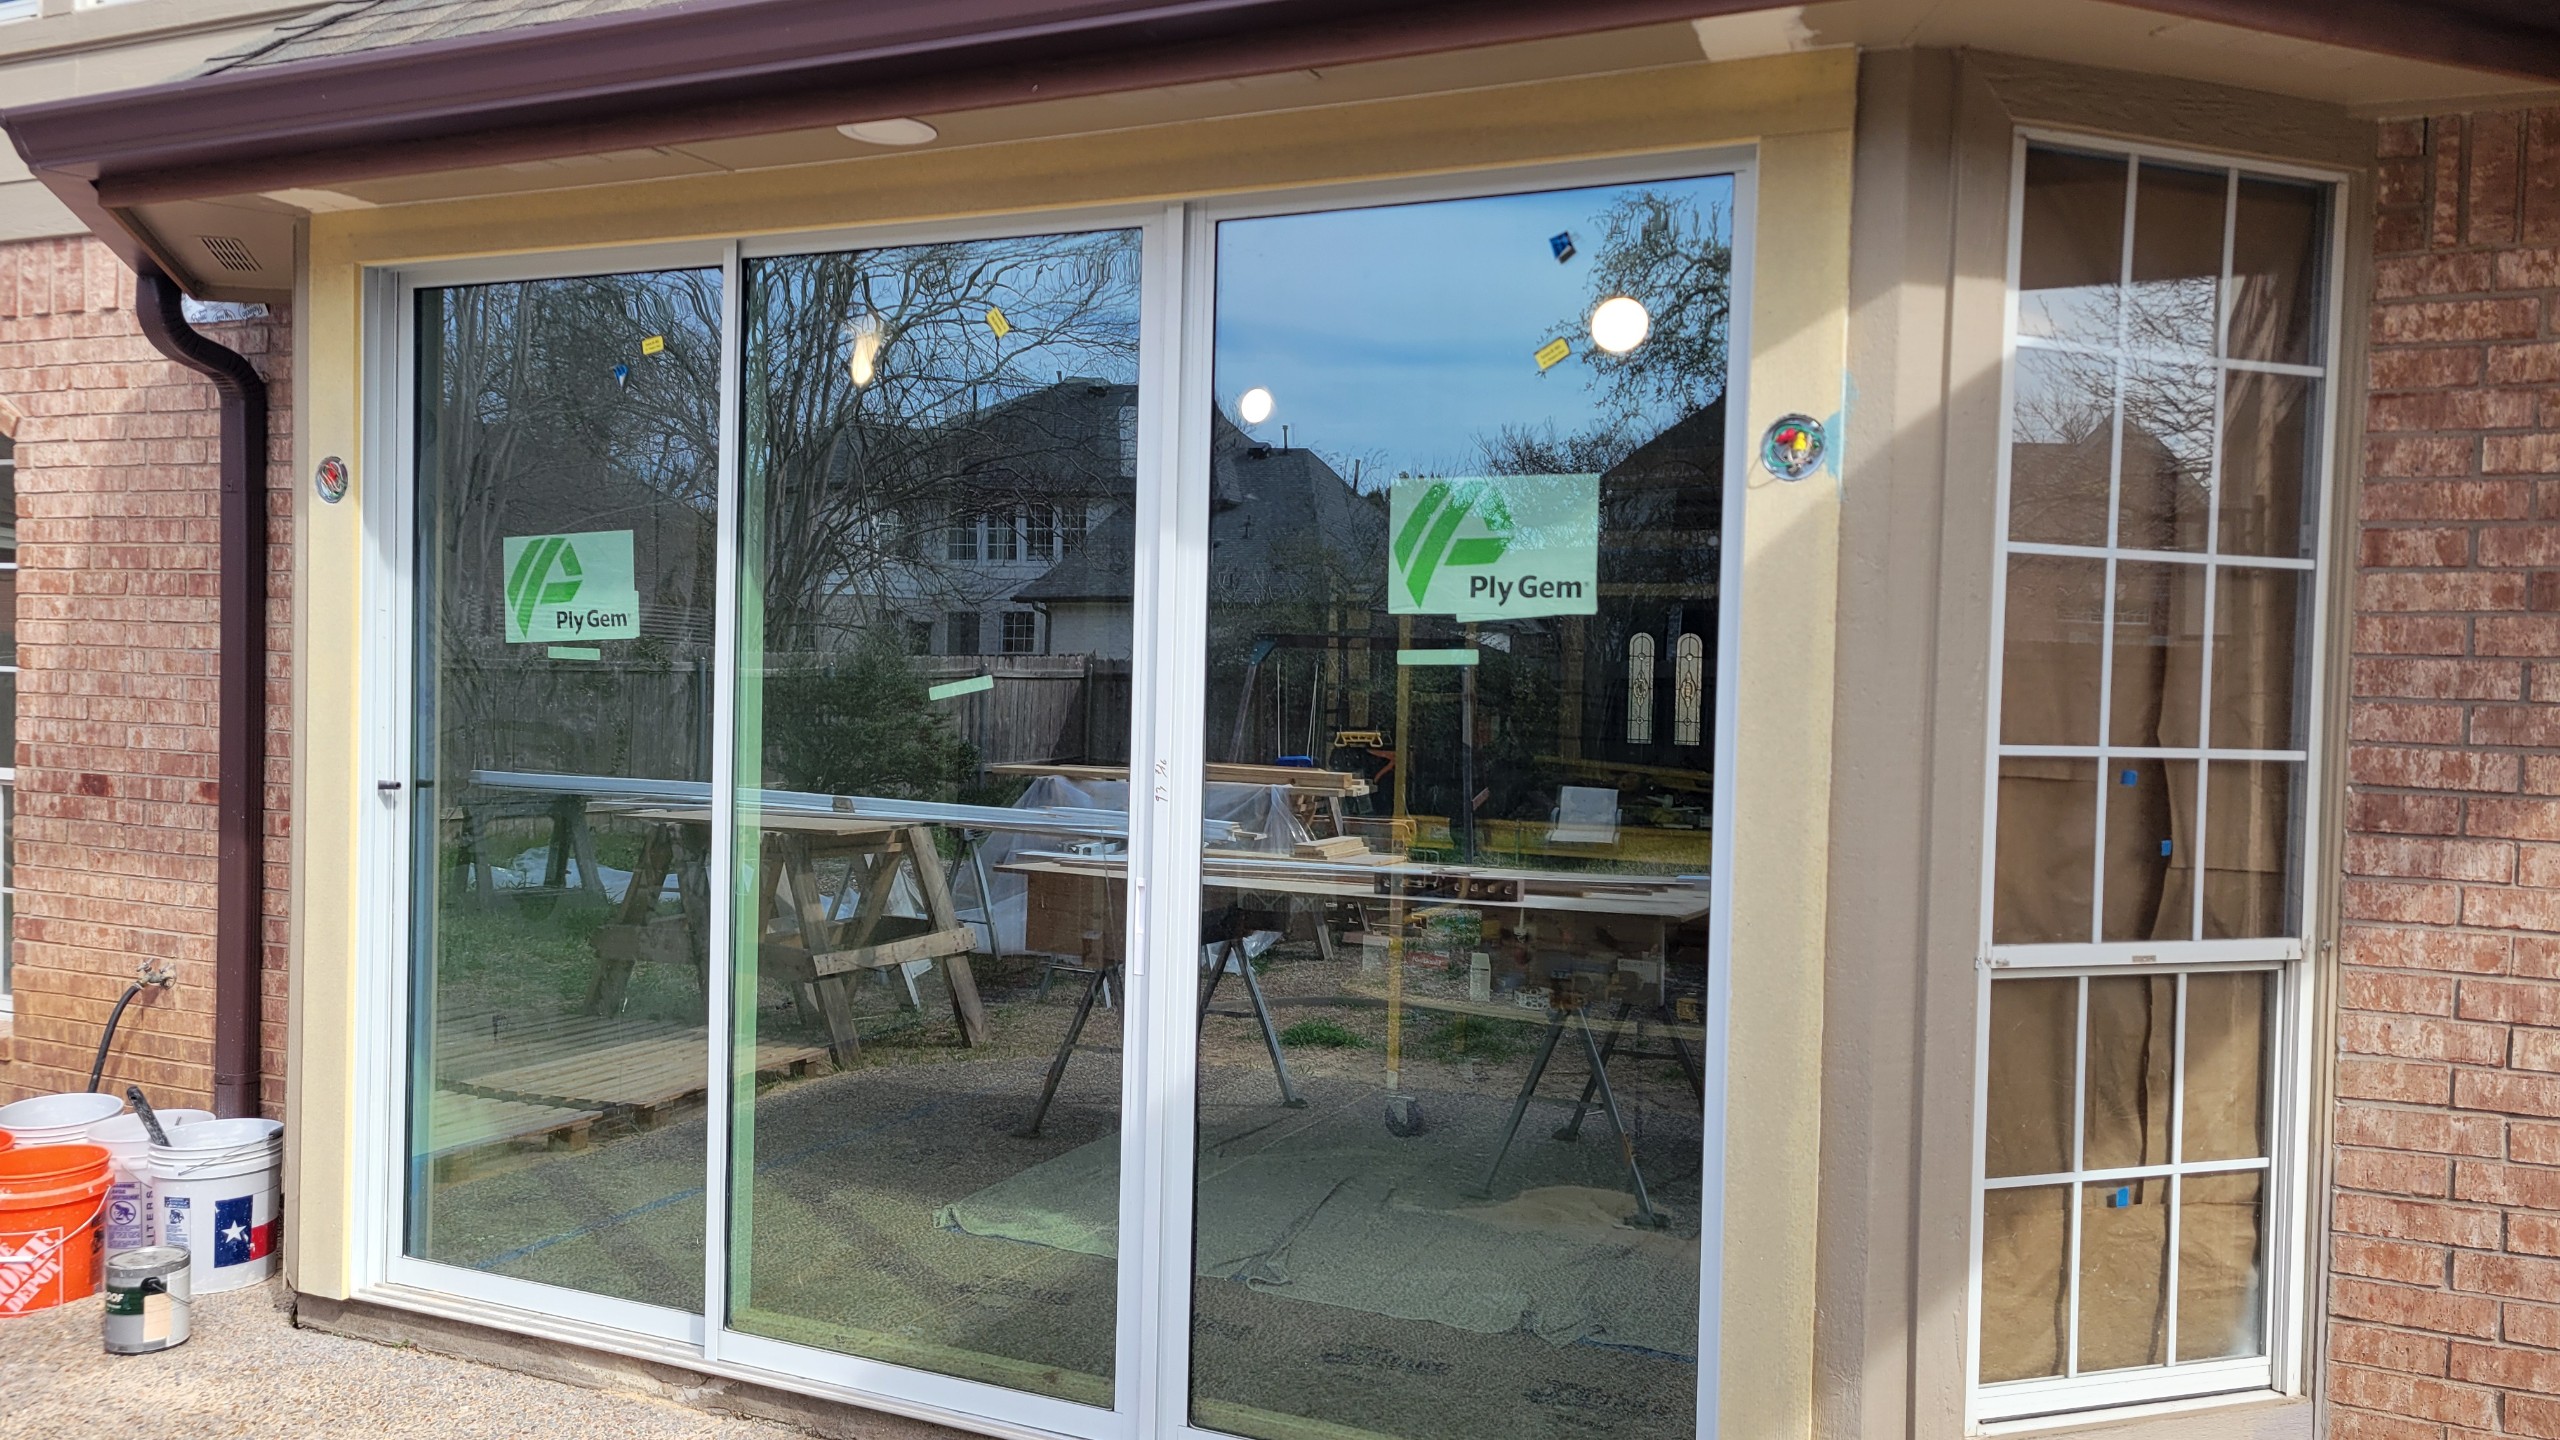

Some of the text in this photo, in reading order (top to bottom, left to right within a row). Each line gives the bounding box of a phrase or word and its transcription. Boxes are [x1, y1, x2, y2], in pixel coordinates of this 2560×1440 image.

[1470, 574, 1582, 607] Ply Gem
[556, 609, 627, 635] Ply Gem
[146, 1190, 155, 1247] LITERS
[0, 1230, 60, 1312] OME DEPOT
